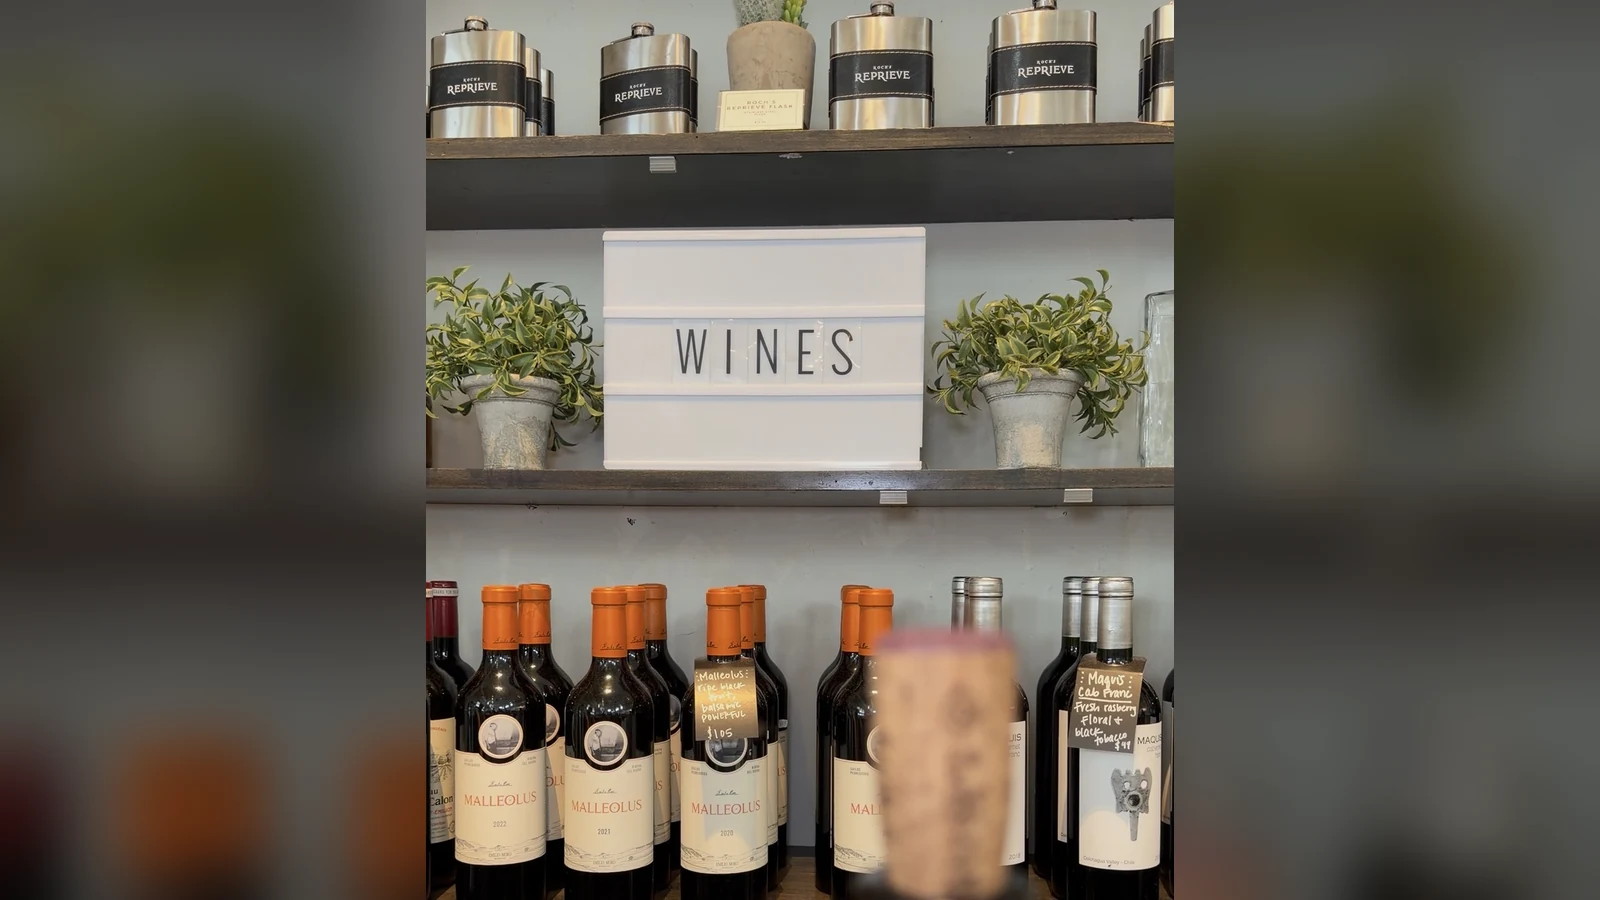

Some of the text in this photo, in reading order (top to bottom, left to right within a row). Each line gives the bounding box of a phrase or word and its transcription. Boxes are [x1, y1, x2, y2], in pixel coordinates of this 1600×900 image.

[854, 71, 911, 83] REPRIEVE
[1018, 65, 1075, 78] REPRIEVE
[447, 82, 498, 95] REPRIEVE
[615, 87, 662, 103] REPRIEVE
[676, 328, 853, 376] WINES
[1088, 671, 1125, 690] Maquis
[697, 682, 745, 696] ripe black
[1078, 686, 1133, 698] Cab Franc
[702, 701, 741, 713] balsamic
[1074, 701, 1100, 712] Fresh
[1081, 713, 1112, 726] Floral
[707, 726, 733, 740] $105
[1075, 727, 1104, 738] black
[1094, 732, 1127, 746] tobacco
[464, 791, 537, 807] MALLEOLUS
[571, 799, 642, 814] MALLEOLUS
[691, 799, 761, 816] MALLEOLUS
[720, 829, 734, 837] 2020
